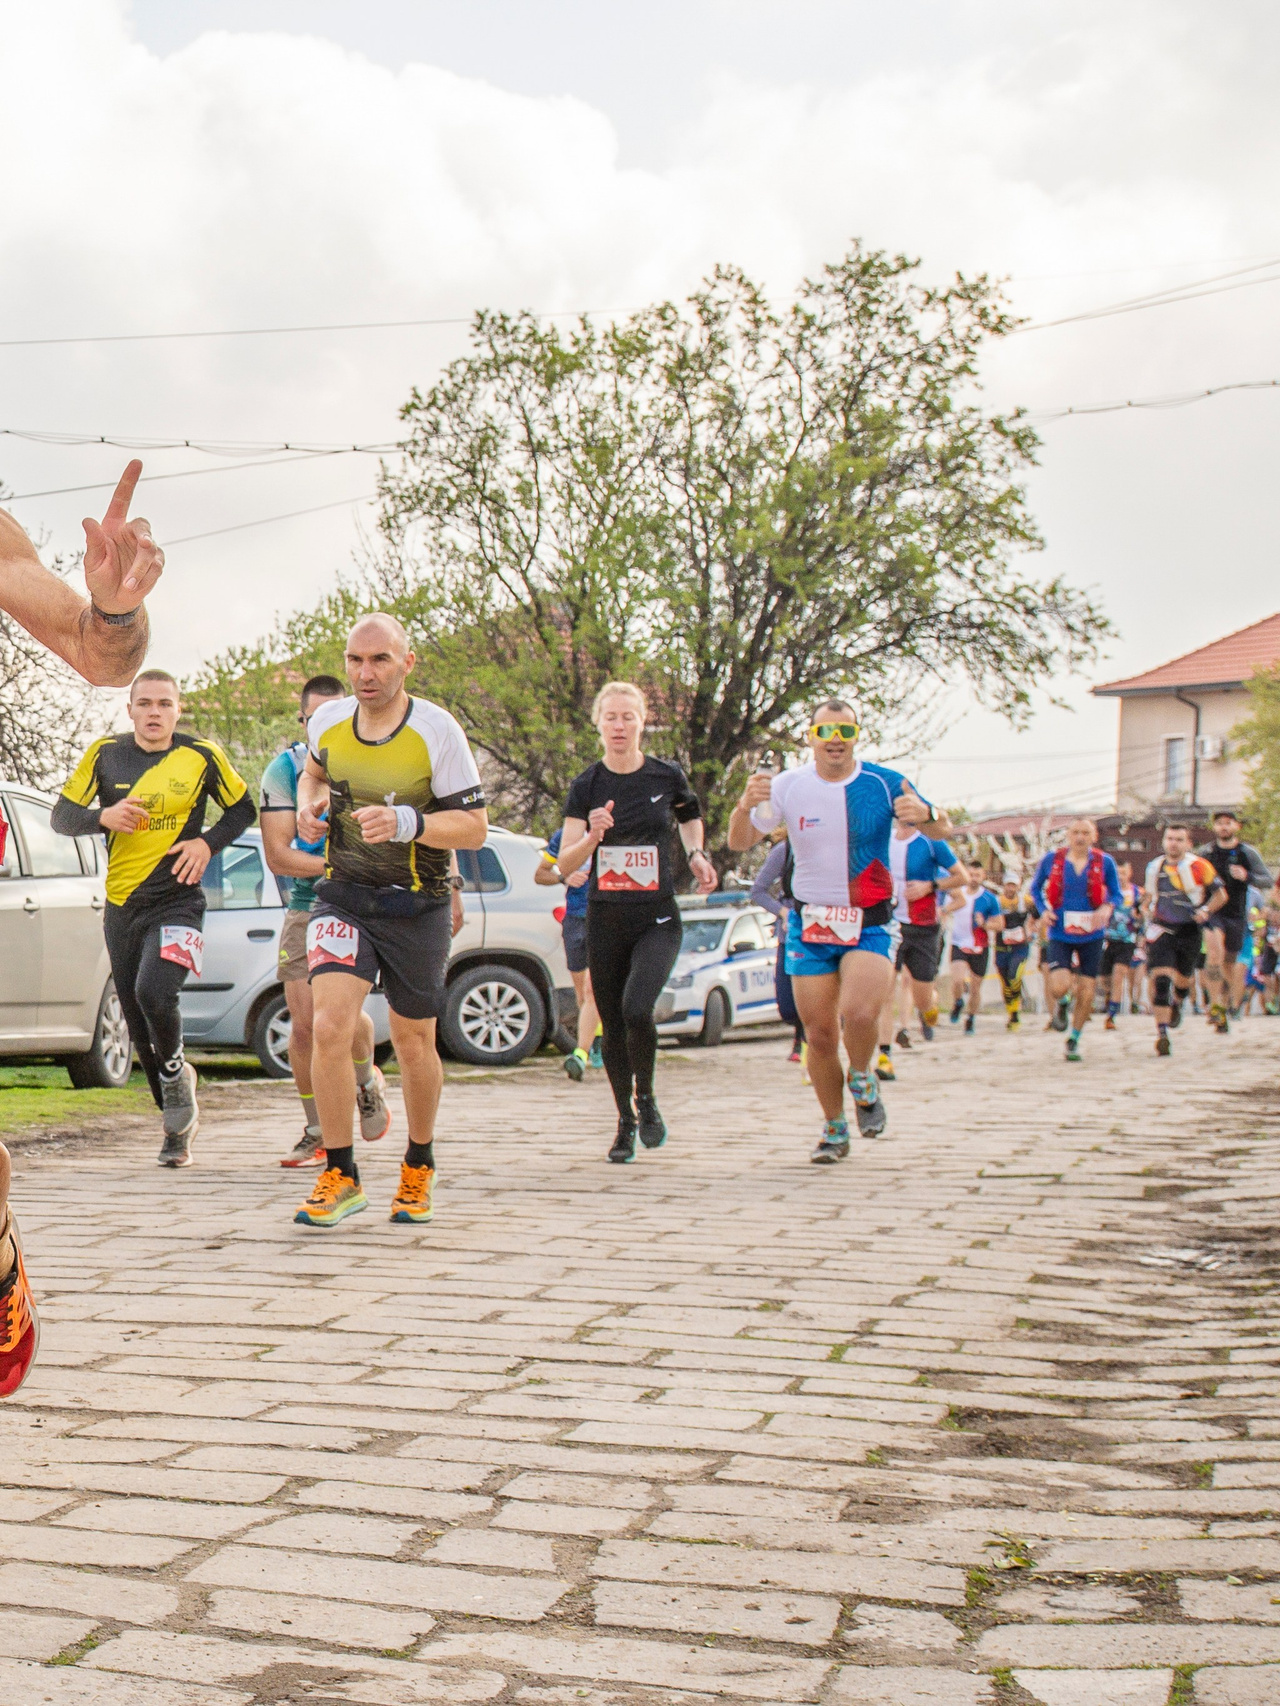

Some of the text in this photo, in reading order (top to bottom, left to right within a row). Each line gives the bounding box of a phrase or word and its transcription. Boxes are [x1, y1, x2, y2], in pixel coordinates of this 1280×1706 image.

[625, 851, 654, 867] 2151
[824, 905, 858, 923] 2199
[315, 921, 354, 941] 2421
